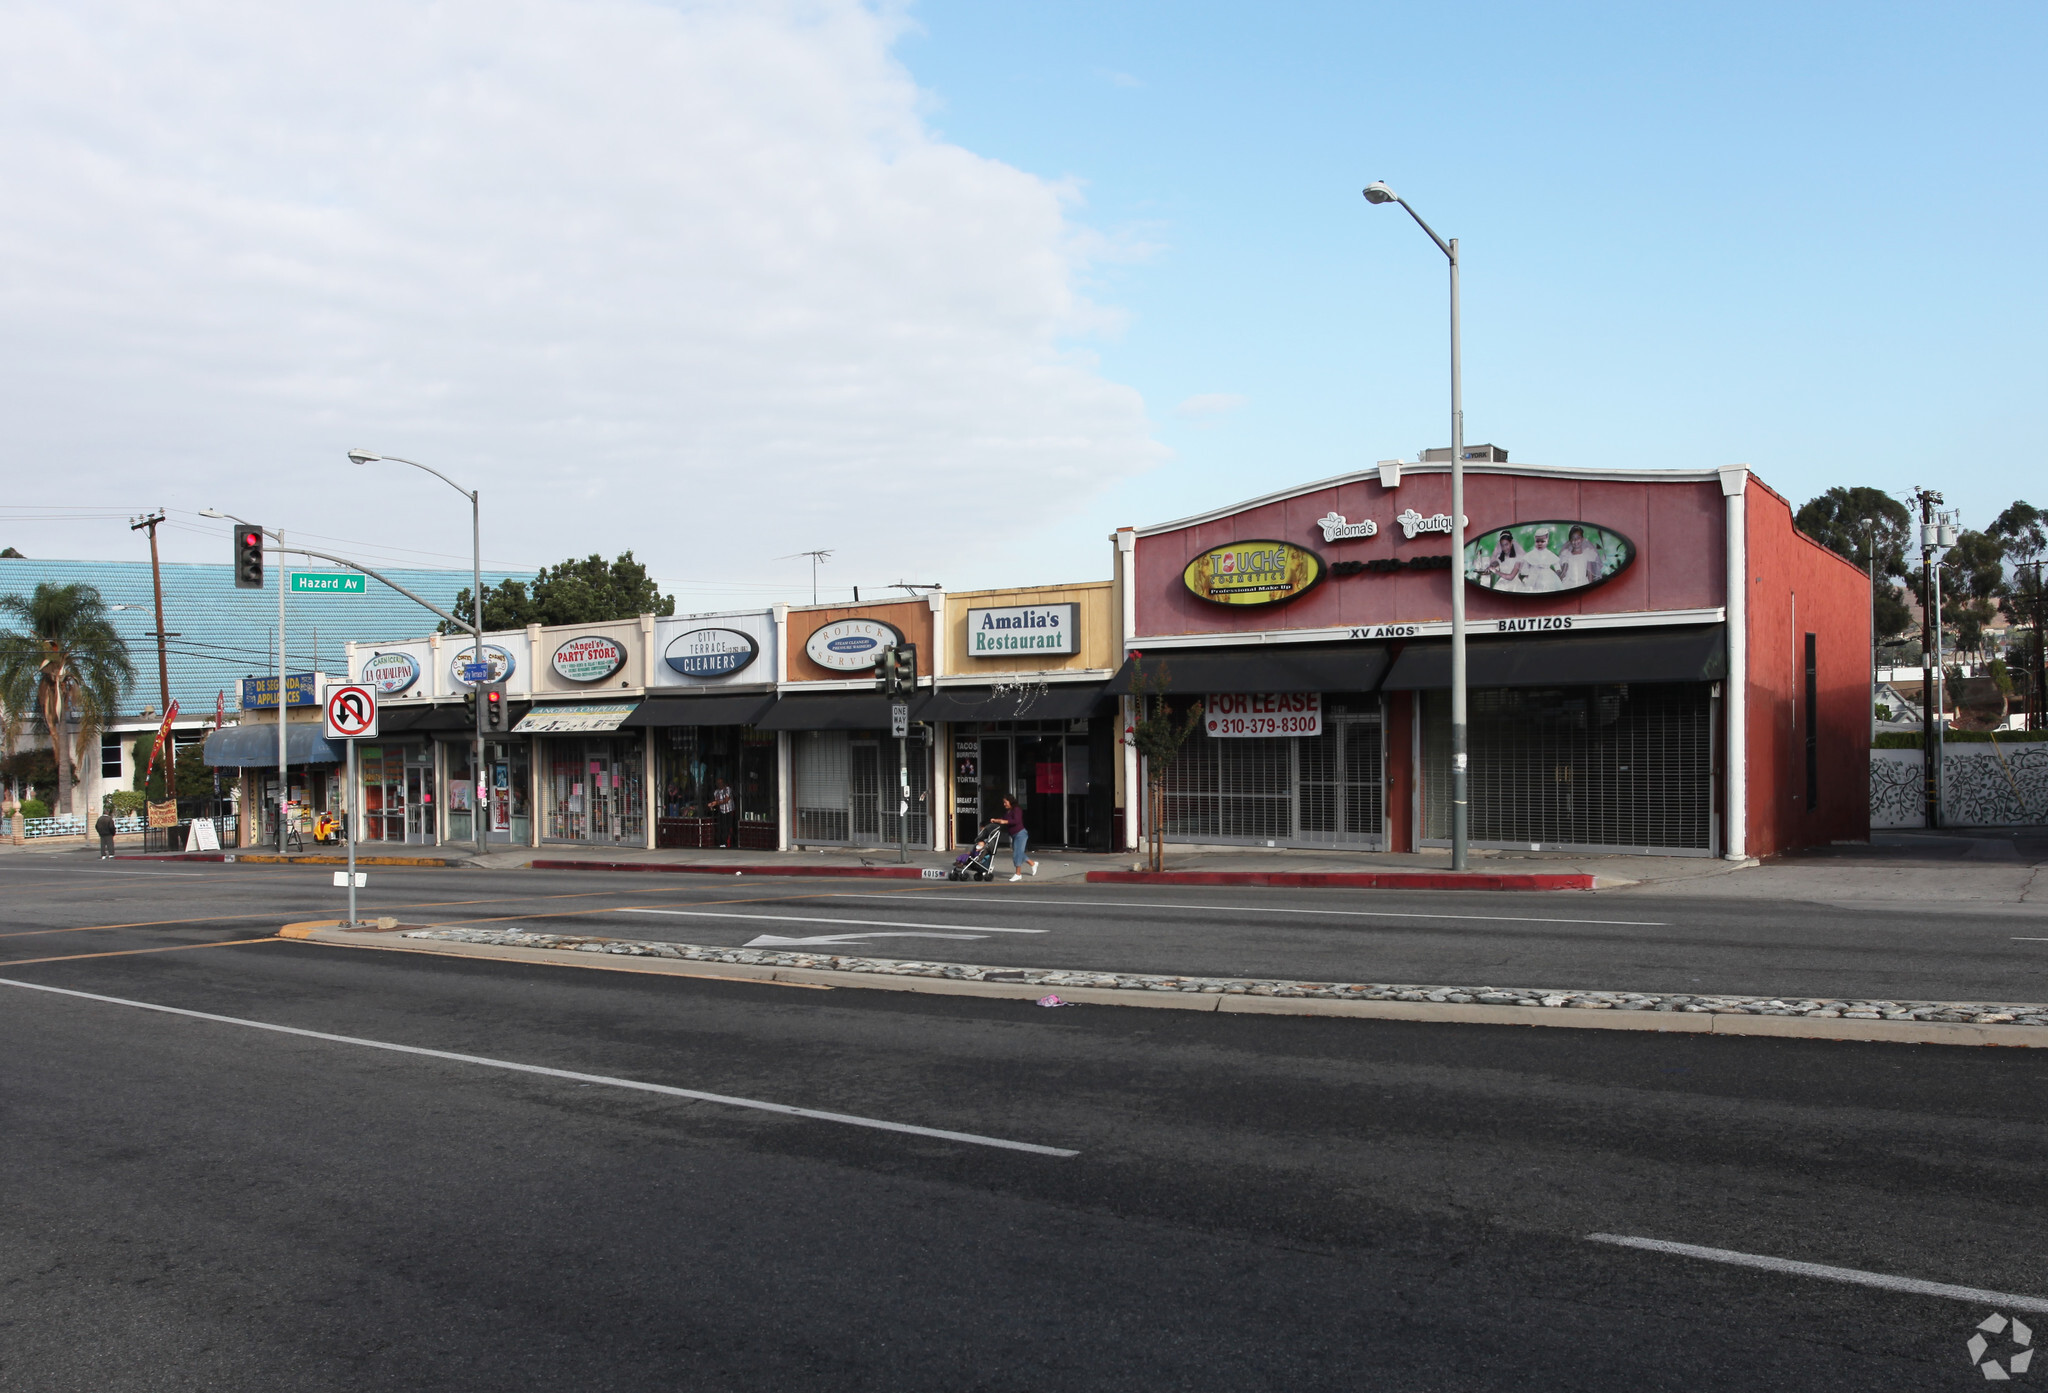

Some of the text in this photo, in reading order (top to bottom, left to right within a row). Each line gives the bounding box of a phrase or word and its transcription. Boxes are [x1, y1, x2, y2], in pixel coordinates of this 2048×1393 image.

[1471, 451, 1487, 459] YORK
[299, 577, 358, 589] Hazard Av
[1210, 571, 1286, 584] COSMETICS
[1210, 586, 1257, 594] Professional
[981, 610, 1060, 630] Amalia's
[1498, 617, 1573, 631] BAUTIZOS
[697, 631, 717, 643] CITY
[822, 624, 884, 640] ROJACK
[1350, 625, 1415, 639] XV AÑOS
[574, 640, 600, 652] Angel's
[976, 631, 1062, 651] Restaurant
[557, 646, 617, 663] PARTY STORE
[690, 642, 726, 655] TERRACE
[684, 655, 735, 672] CLEANERS
[817, 649, 885, 666] SERVIC
[365, 670, 374, 682] LA
[256, 680, 266, 692] DE
[266, 677, 300, 692] SEGNDA
[257, 690, 301, 705] APPLIACES
[1208, 693, 1248, 714] FOR
[1252, 692, 1319, 714] LEASE
[893, 707, 907, 716] ONE
[893, 716, 907, 724] WAY
[1221, 716, 1317, 733] 310-379-8300
[956, 742, 978, 750] TACOS
[923, 870, 939, 878] 4015
